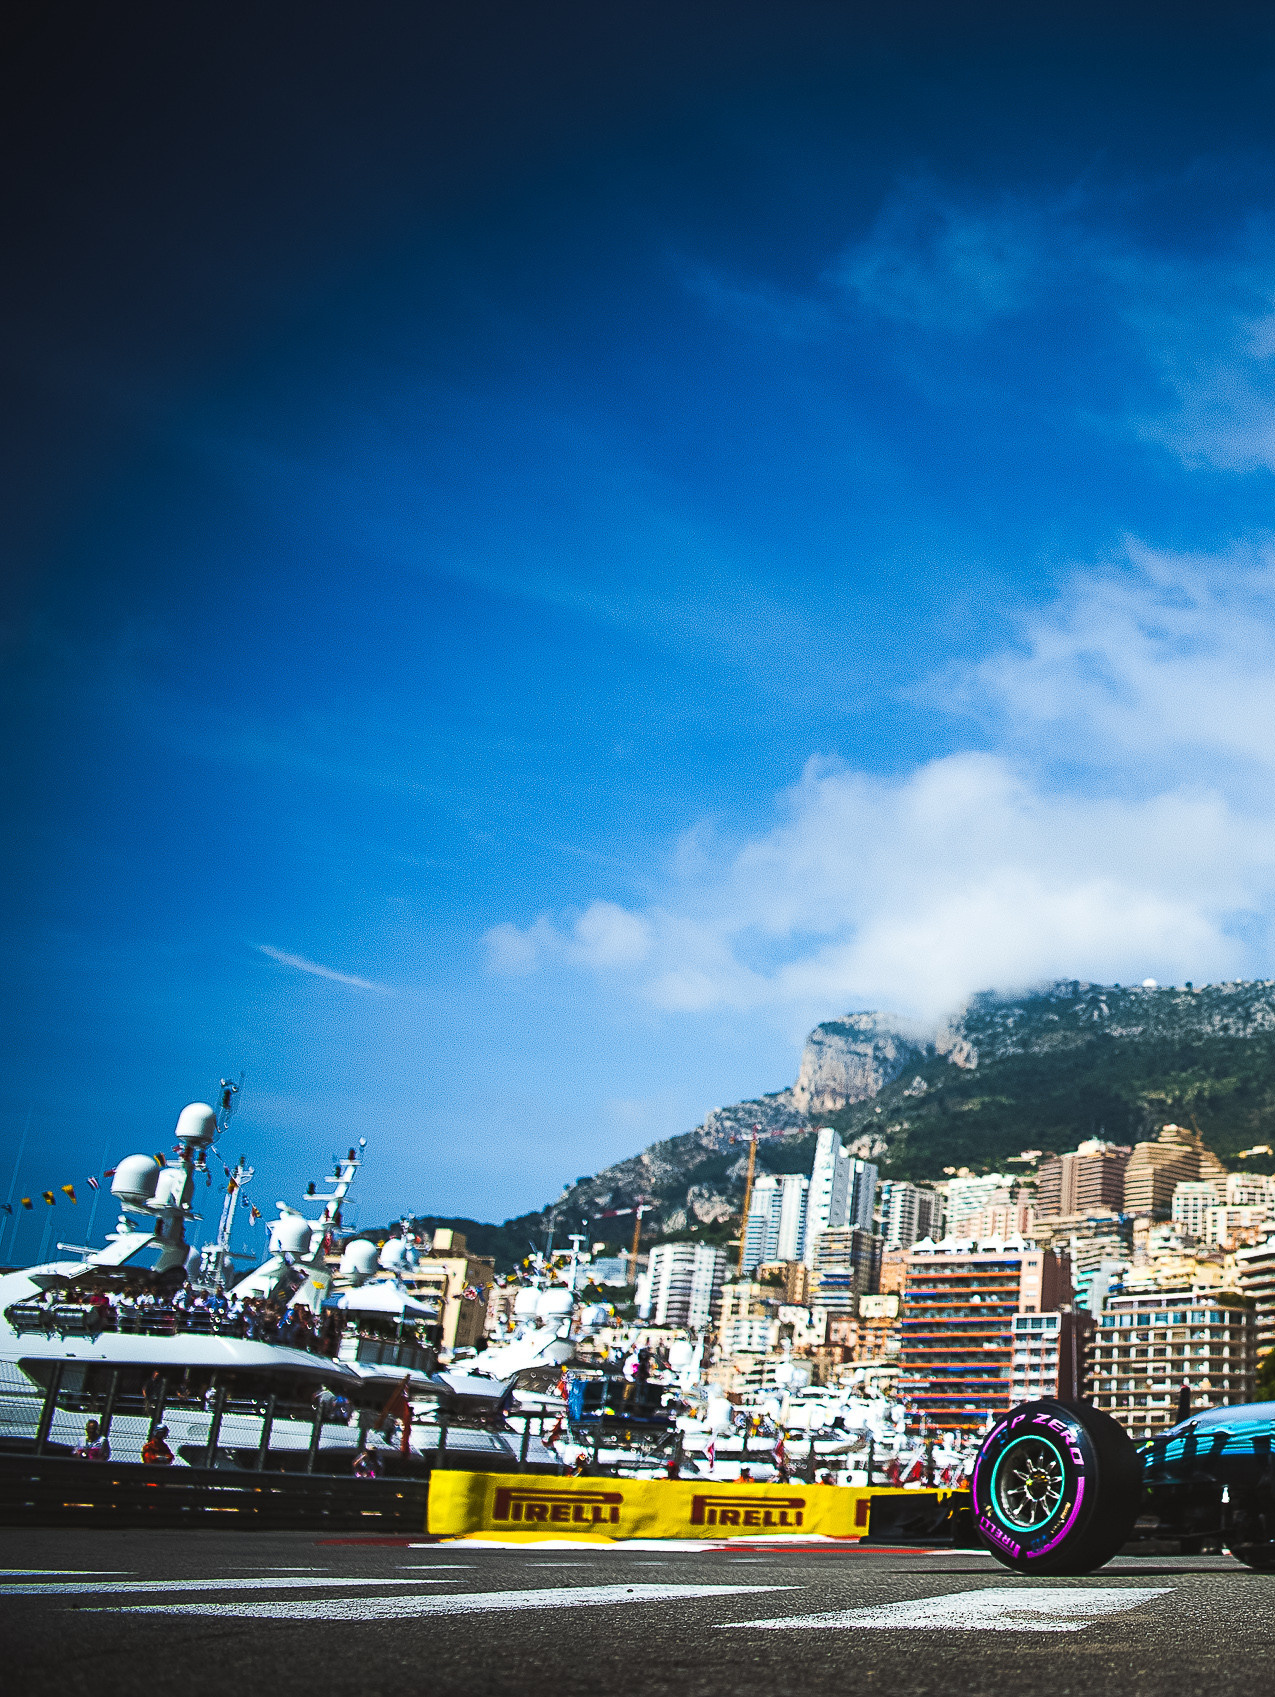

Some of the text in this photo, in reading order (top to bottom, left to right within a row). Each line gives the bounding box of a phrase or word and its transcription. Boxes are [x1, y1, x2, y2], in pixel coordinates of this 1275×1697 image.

[1011, 1414, 1027, 1429] P
[1032, 1413, 1085, 1466] ZERO
[493, 1486, 624, 1525] PIRELLI
[690, 1494, 806, 1527] PIRELLI
[979, 1516, 1021, 1559] PIRELLI
